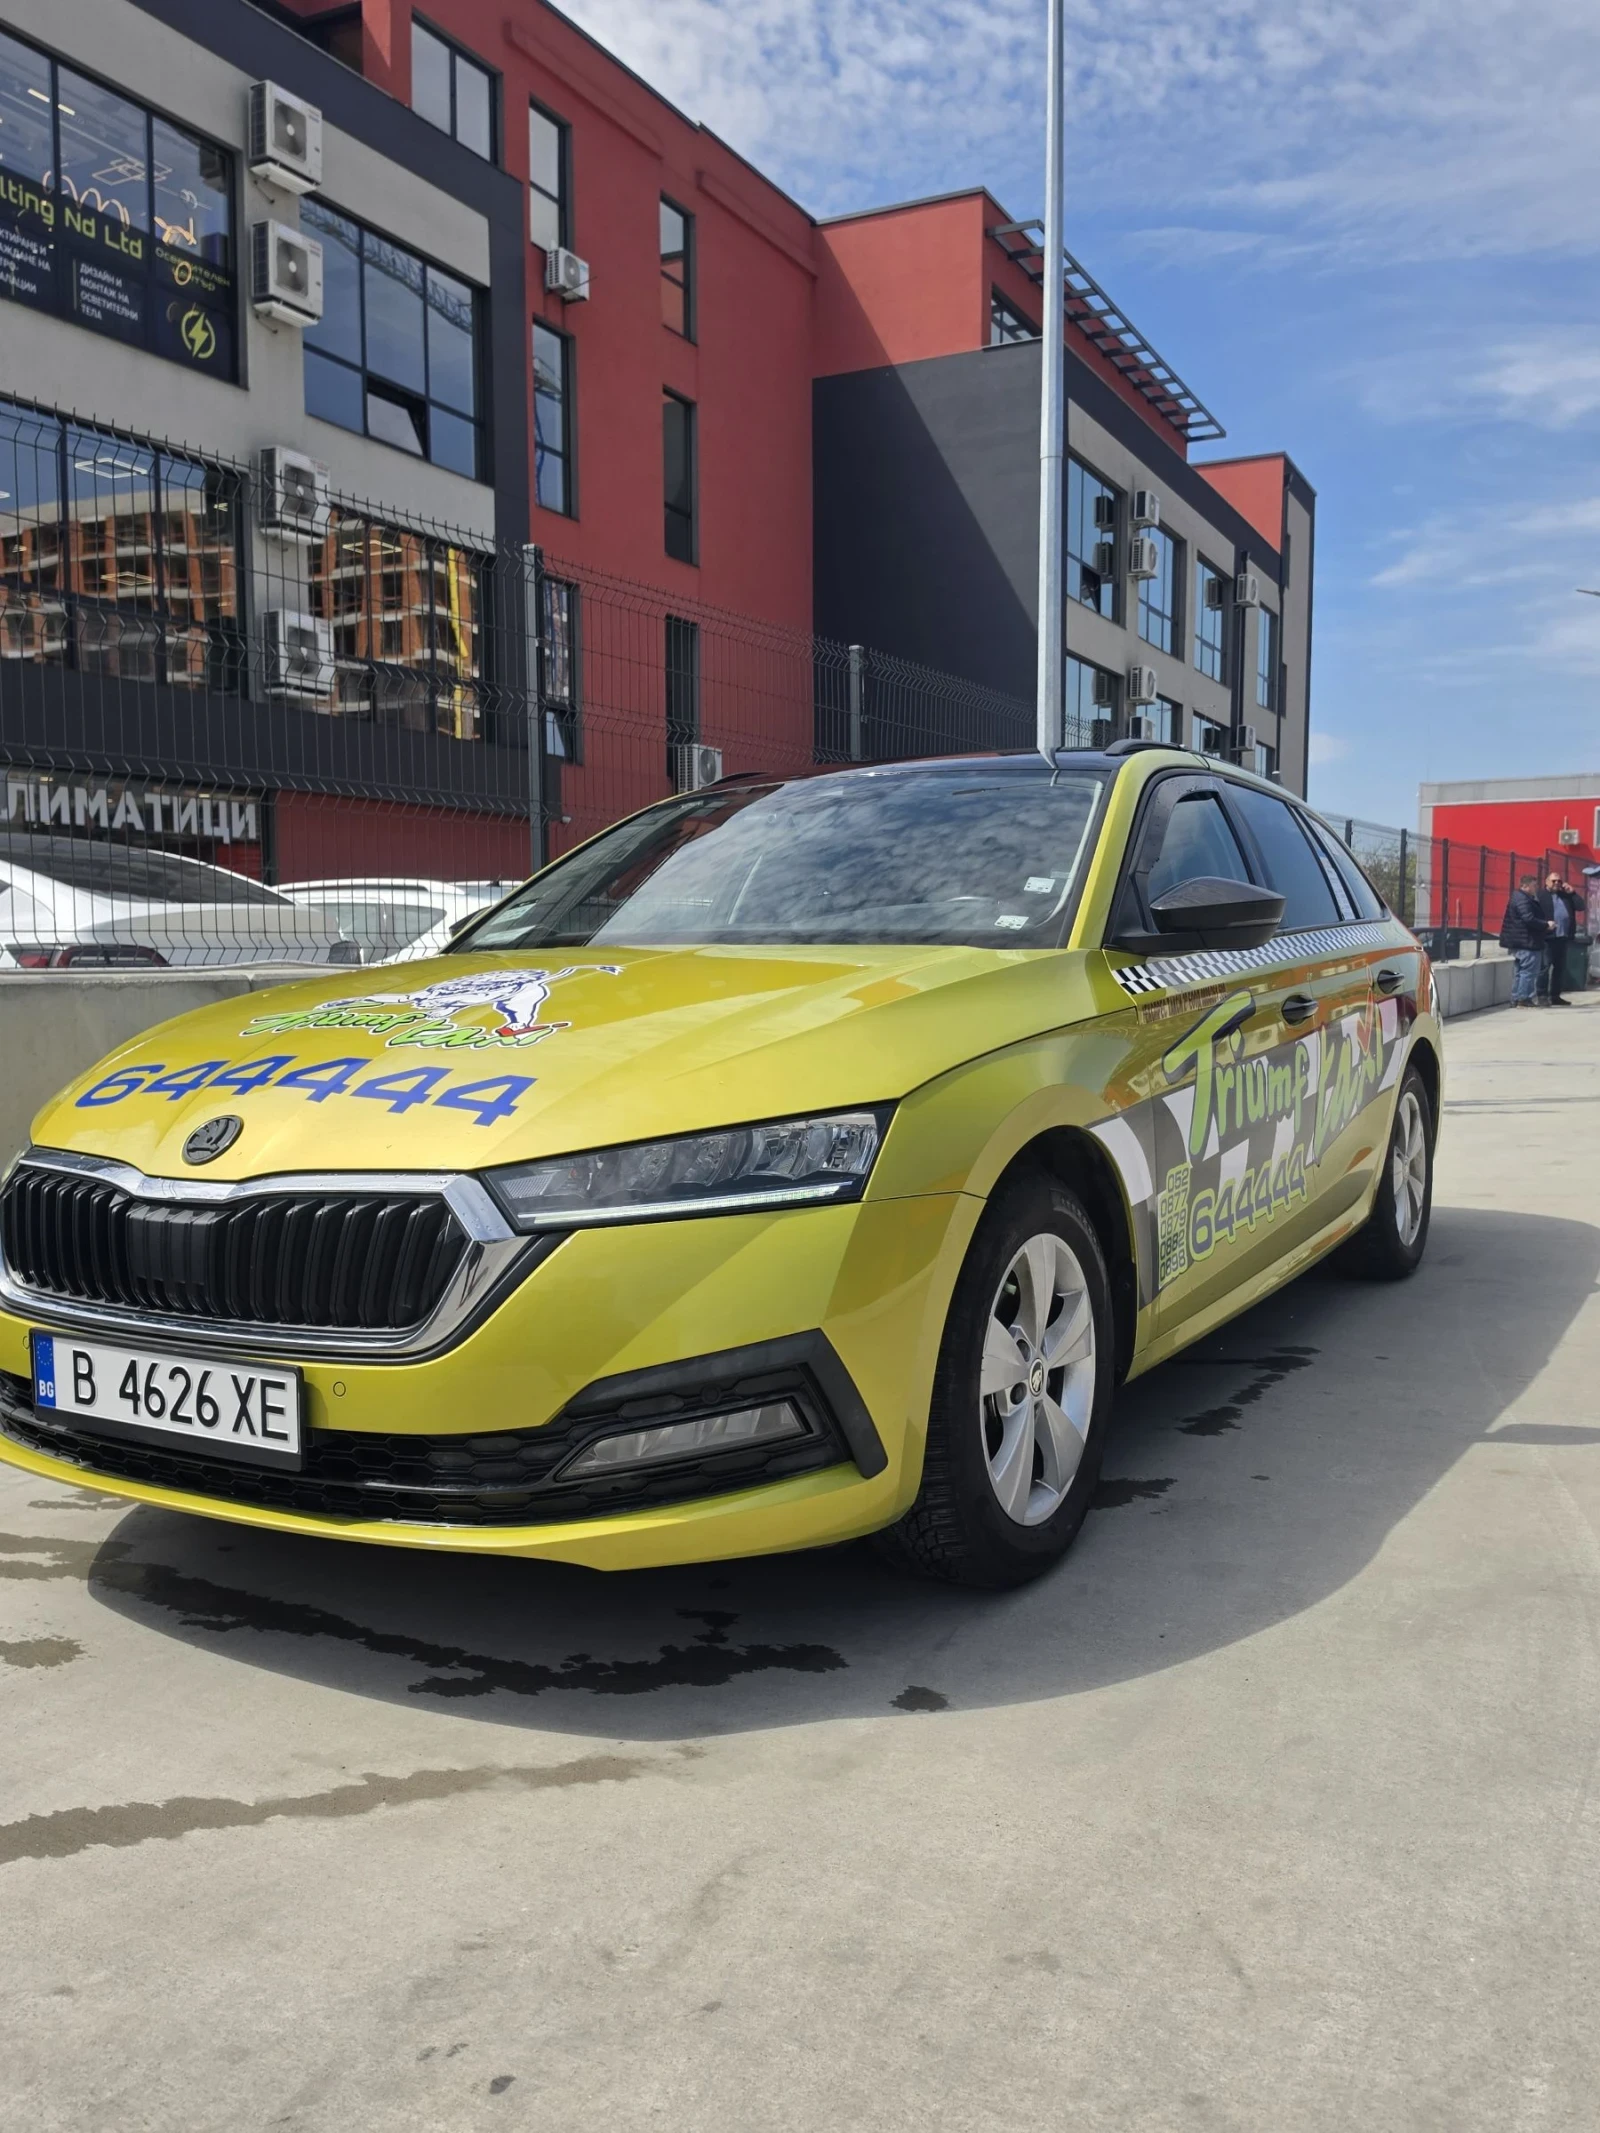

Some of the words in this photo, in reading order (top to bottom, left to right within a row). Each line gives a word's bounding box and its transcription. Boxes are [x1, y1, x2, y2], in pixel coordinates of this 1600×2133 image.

[0, 175, 55, 226] lting
[64, 206, 96, 240] Nd
[104, 224, 142, 260] Ltd
[81, 303, 103, 321] ТЕЛА
[74, 1055, 538, 1127] 644444
[1167, 1167, 1190, 1193] 052
[1160, 1190, 1188, 1219] 0877
[1190, 1146, 1307, 1256] 644444
[1160, 1208, 1187, 1240] 0879
[1159, 1232, 1186, 1262] 0882
[1159, 1248, 1187, 1283] 0898
[39, 1378, 54, 1398] BG
[72, 1349, 97, 1406] B
[119, 1358, 220, 1429] 4626
[230, 1373, 289, 1441] XE
